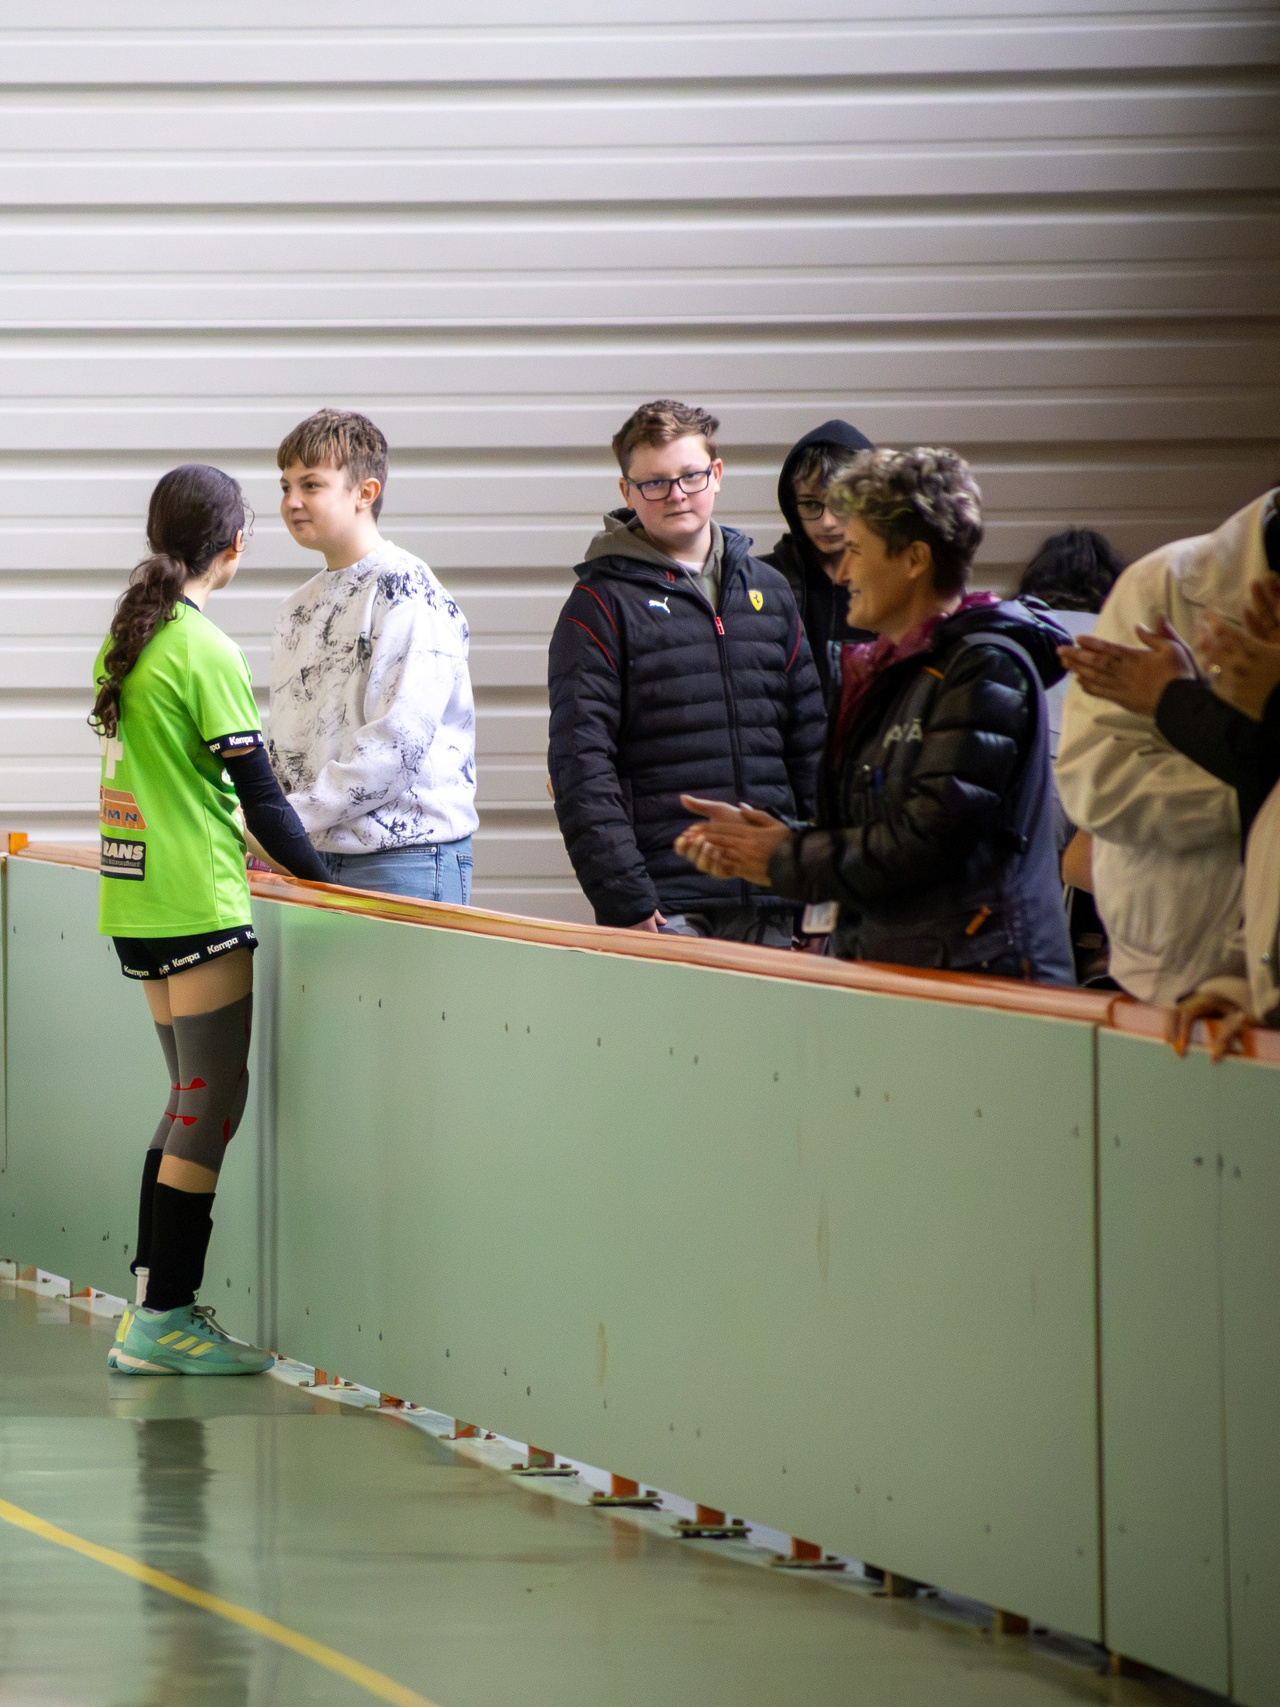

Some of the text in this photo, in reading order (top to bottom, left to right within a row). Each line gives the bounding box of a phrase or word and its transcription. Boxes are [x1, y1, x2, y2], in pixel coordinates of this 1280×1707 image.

[228, 735, 254, 746] Kempa
[206, 937, 239, 955] Kempa
[172, 952, 200, 968] Kempa
[123, 964, 150, 978] Kempa
